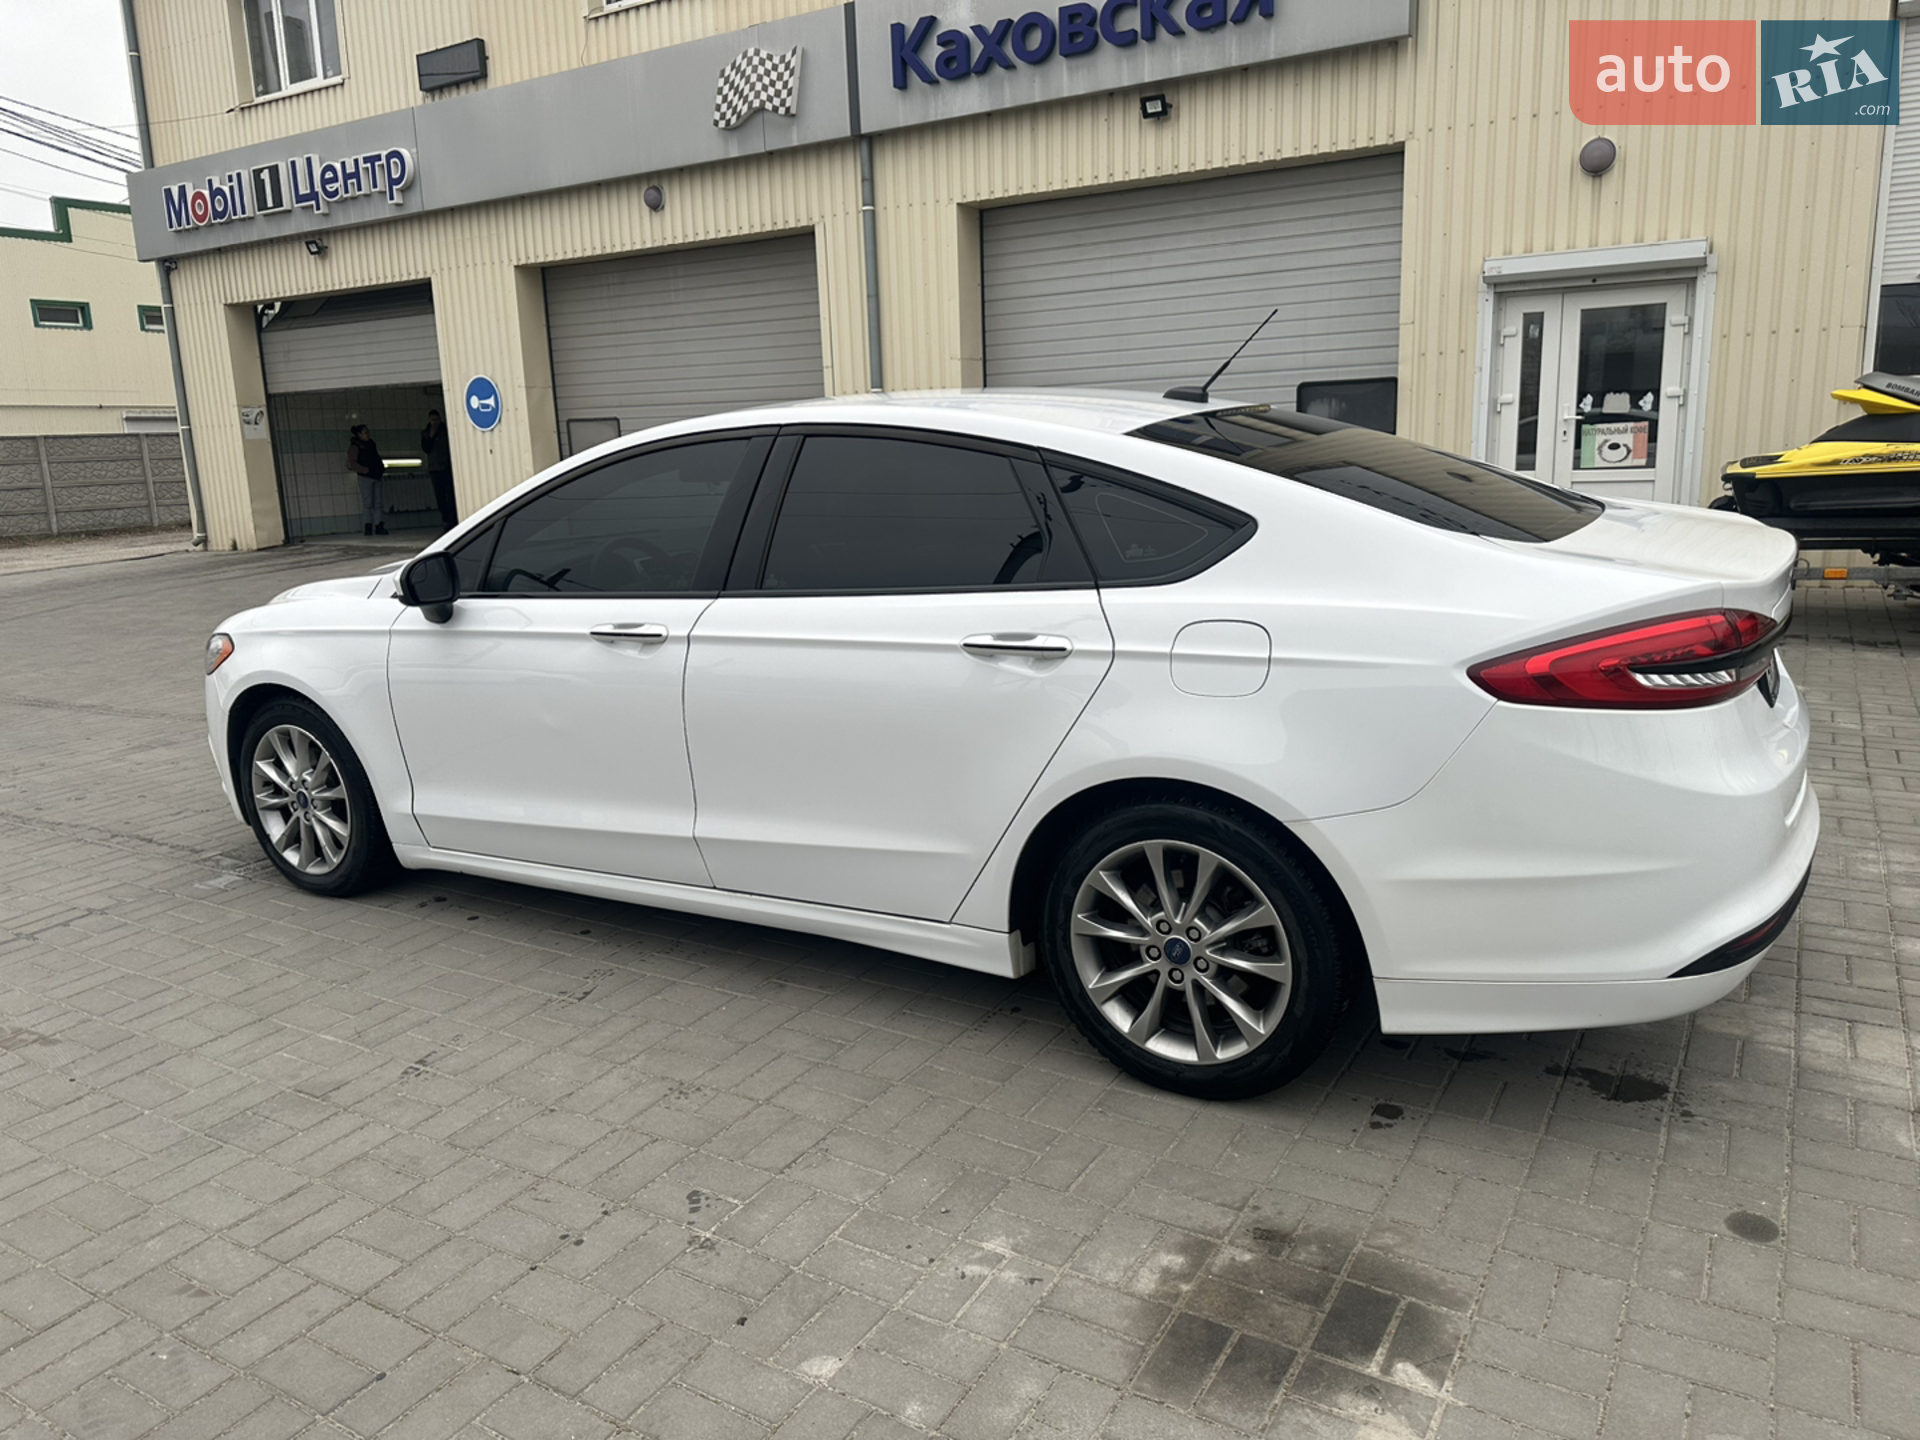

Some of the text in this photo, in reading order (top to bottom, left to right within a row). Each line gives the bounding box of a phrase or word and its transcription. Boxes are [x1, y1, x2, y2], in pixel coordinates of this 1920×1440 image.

[163, 148, 411, 231] Mobil 1 Центр
[1582, 425, 1629, 435] НАТУРАЛЬНЫЙ
